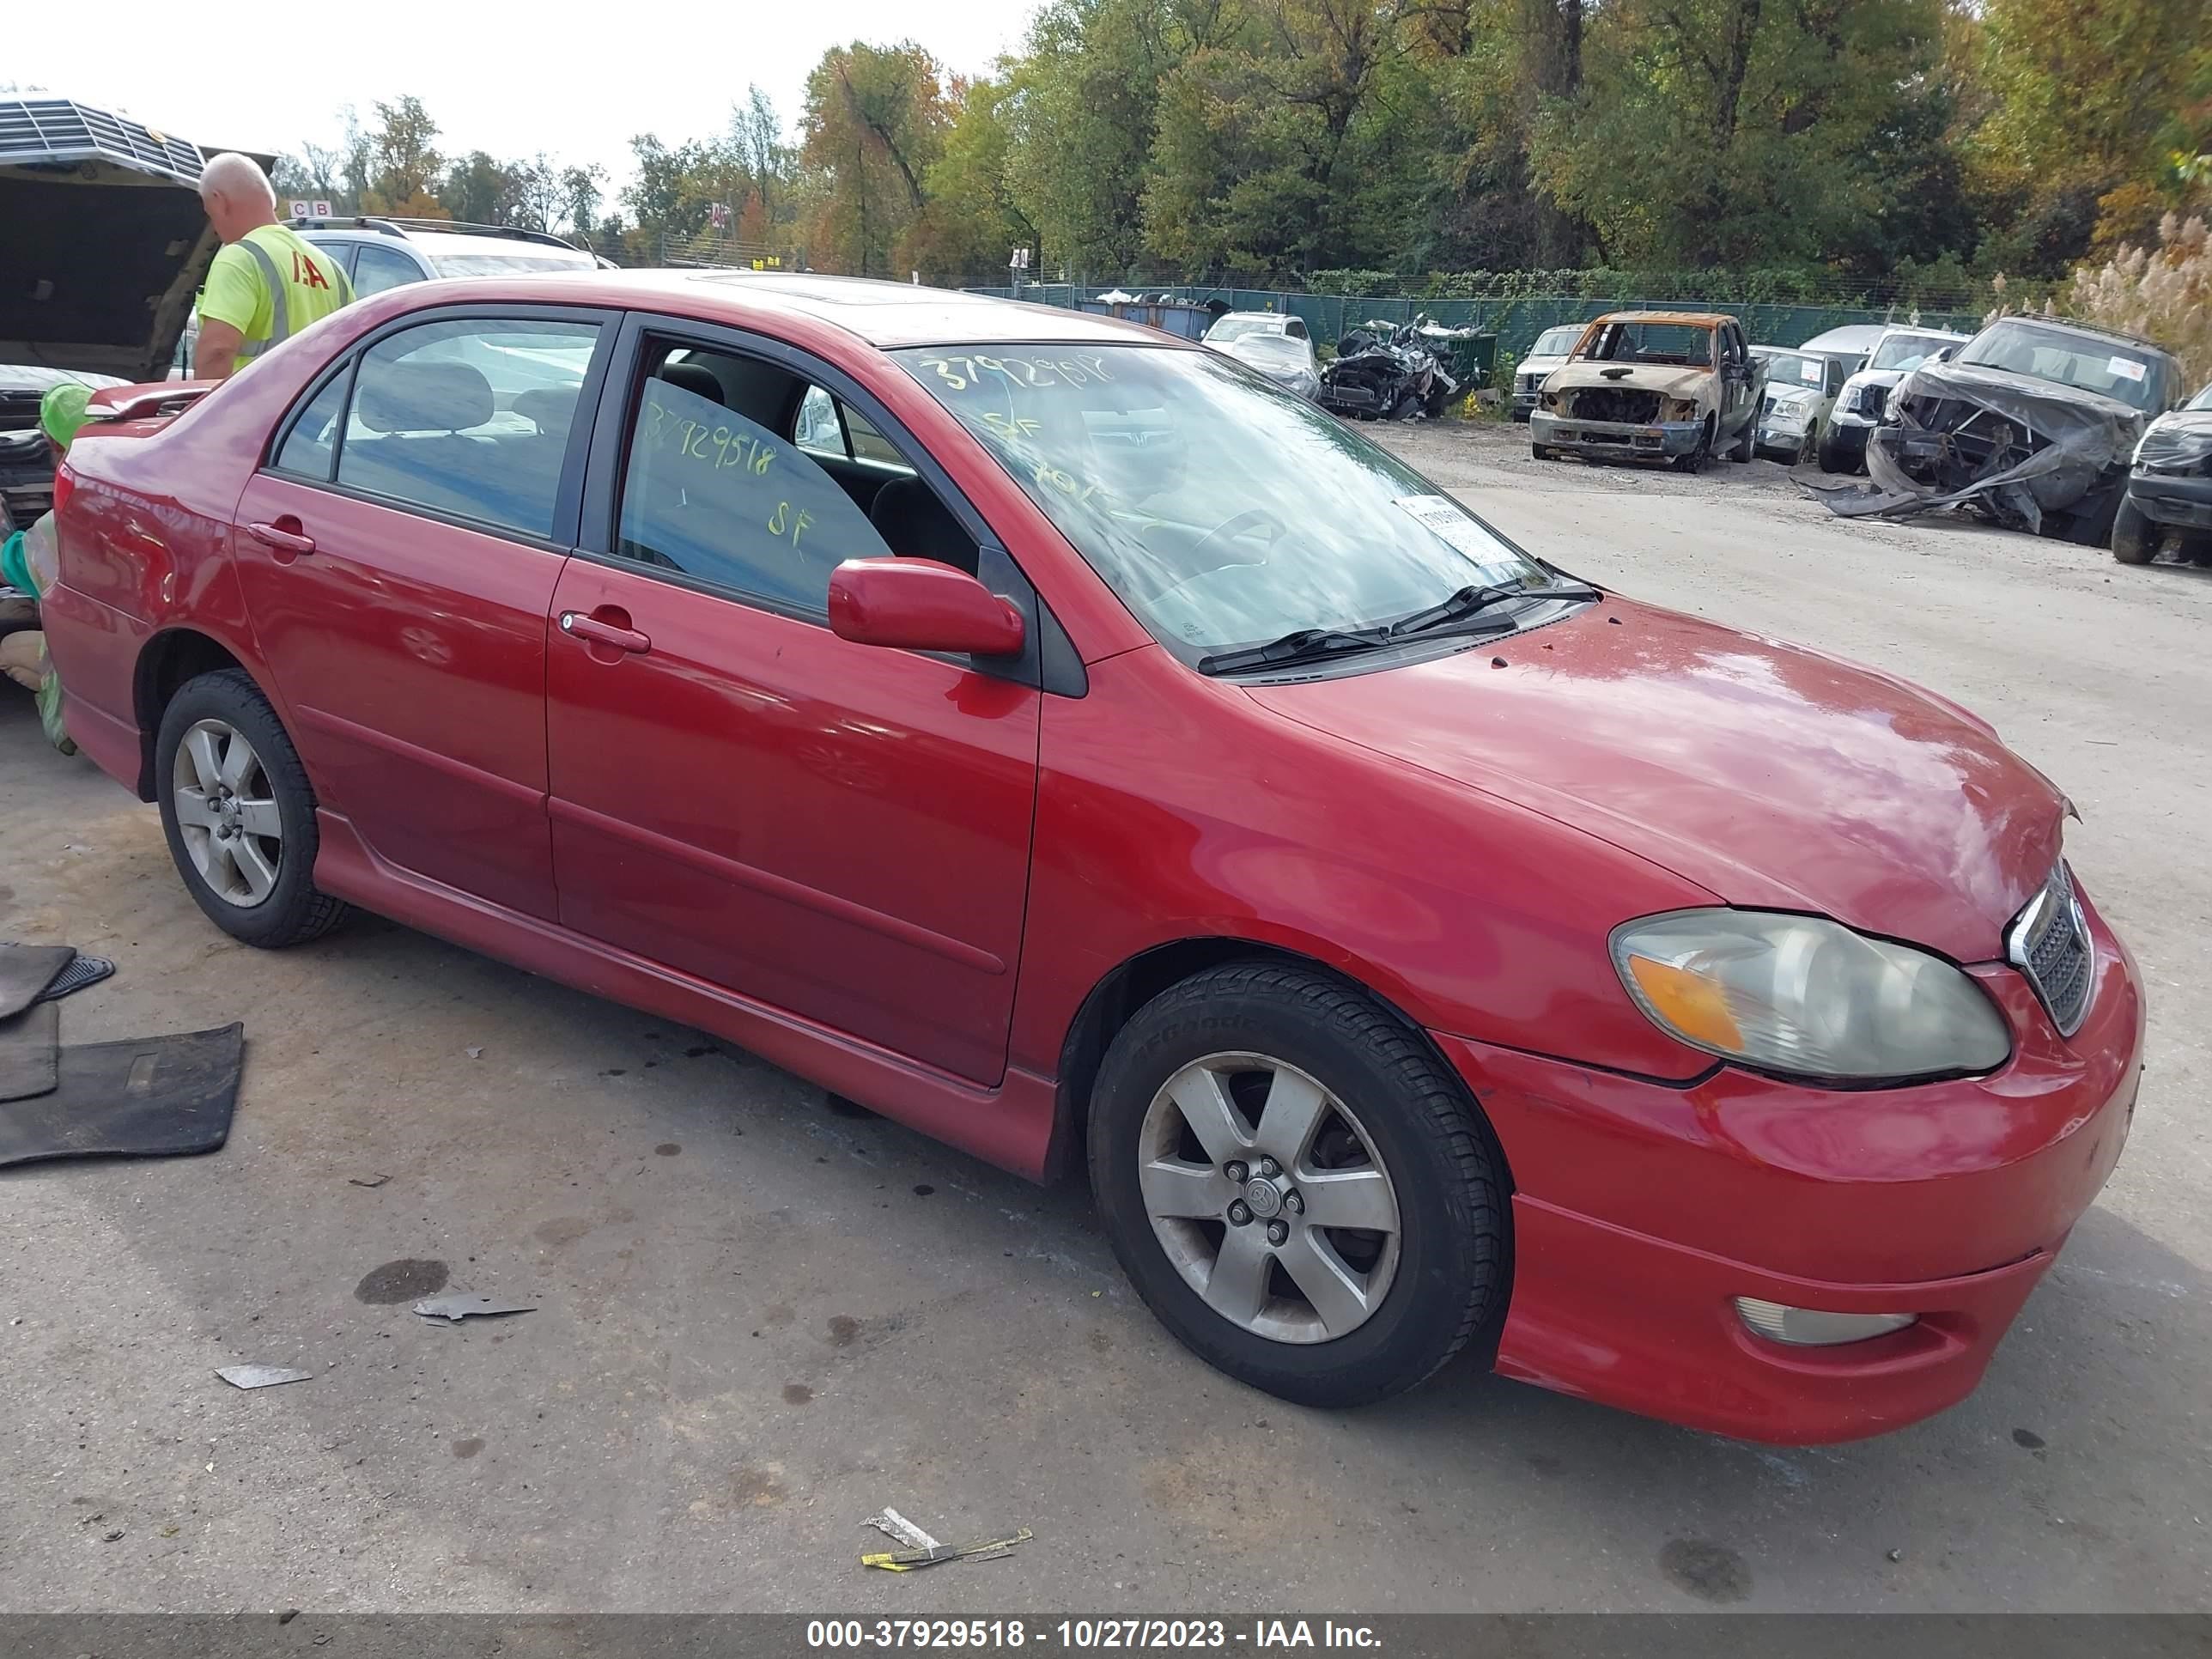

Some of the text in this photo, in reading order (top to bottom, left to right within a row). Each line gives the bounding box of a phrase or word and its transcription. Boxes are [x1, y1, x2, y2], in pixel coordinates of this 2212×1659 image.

[295, 204, 327, 215] C B
[293, 251, 330, 289] IA
[919, 355, 1115, 391] 37929518
[645, 402, 777, 475] 37929518
[769, 501, 816, 547] SF
